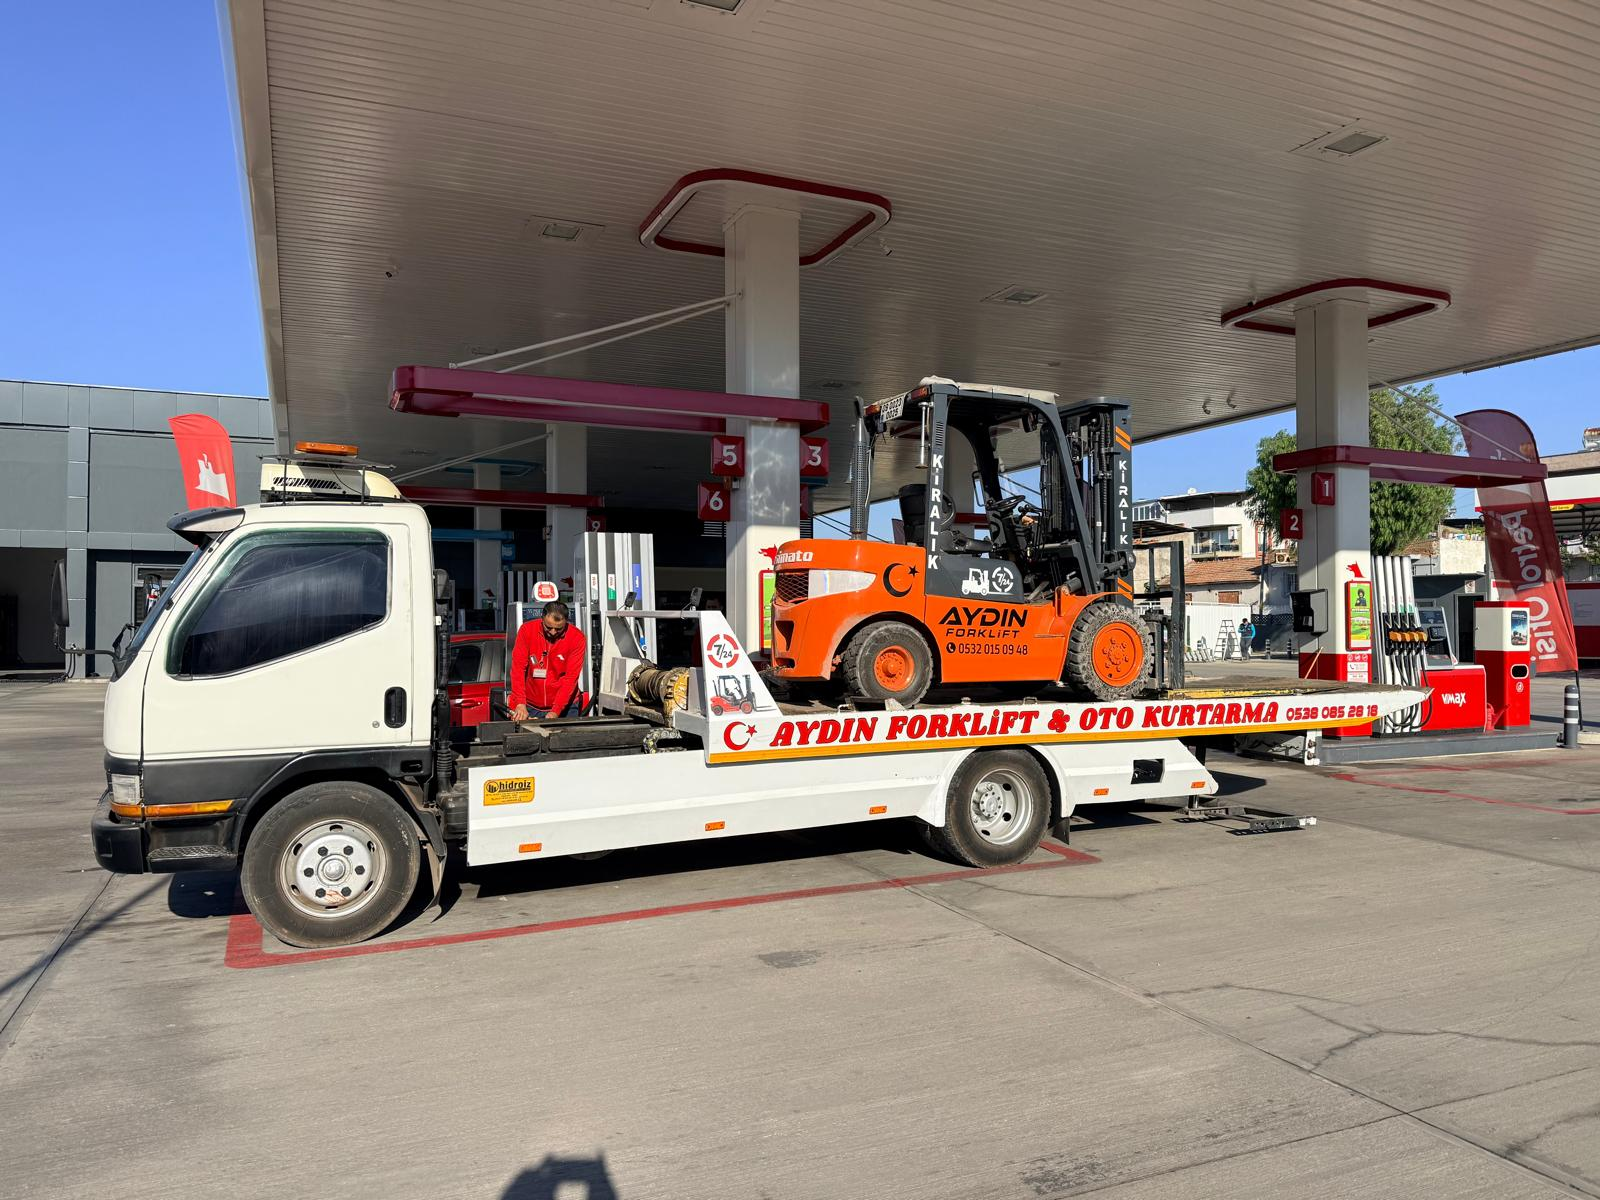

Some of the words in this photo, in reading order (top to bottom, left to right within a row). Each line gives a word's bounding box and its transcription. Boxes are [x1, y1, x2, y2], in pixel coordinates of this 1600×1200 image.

[722, 445, 737, 466] 5
[807, 446, 822, 466] 3
[1323, 480, 1329, 496] 1
[709, 491, 723, 510] 6
[592, 521, 600, 532] 9
[1290, 515, 1299, 531] 2
[939, 606, 1028, 627] AYDIN
[713, 643, 733, 660] 7/24
[958, 643, 982, 654] 0532
[984, 643, 1000, 655] 015
[1002, 644, 1014, 655] 09
[1016, 644, 1028, 655] 48
[769, 716, 878, 747] AYDIN
[1046, 709, 1070, 733] &
[1078, 706, 1135, 731] OTO
[1141, 702, 1279, 728] KURTARMA
[1286, 706, 1319, 722] 0538
[1322, 705, 1345, 719] 085
[1347, 705, 1365, 718] 28
[1366, 704, 1378, 717] 18
